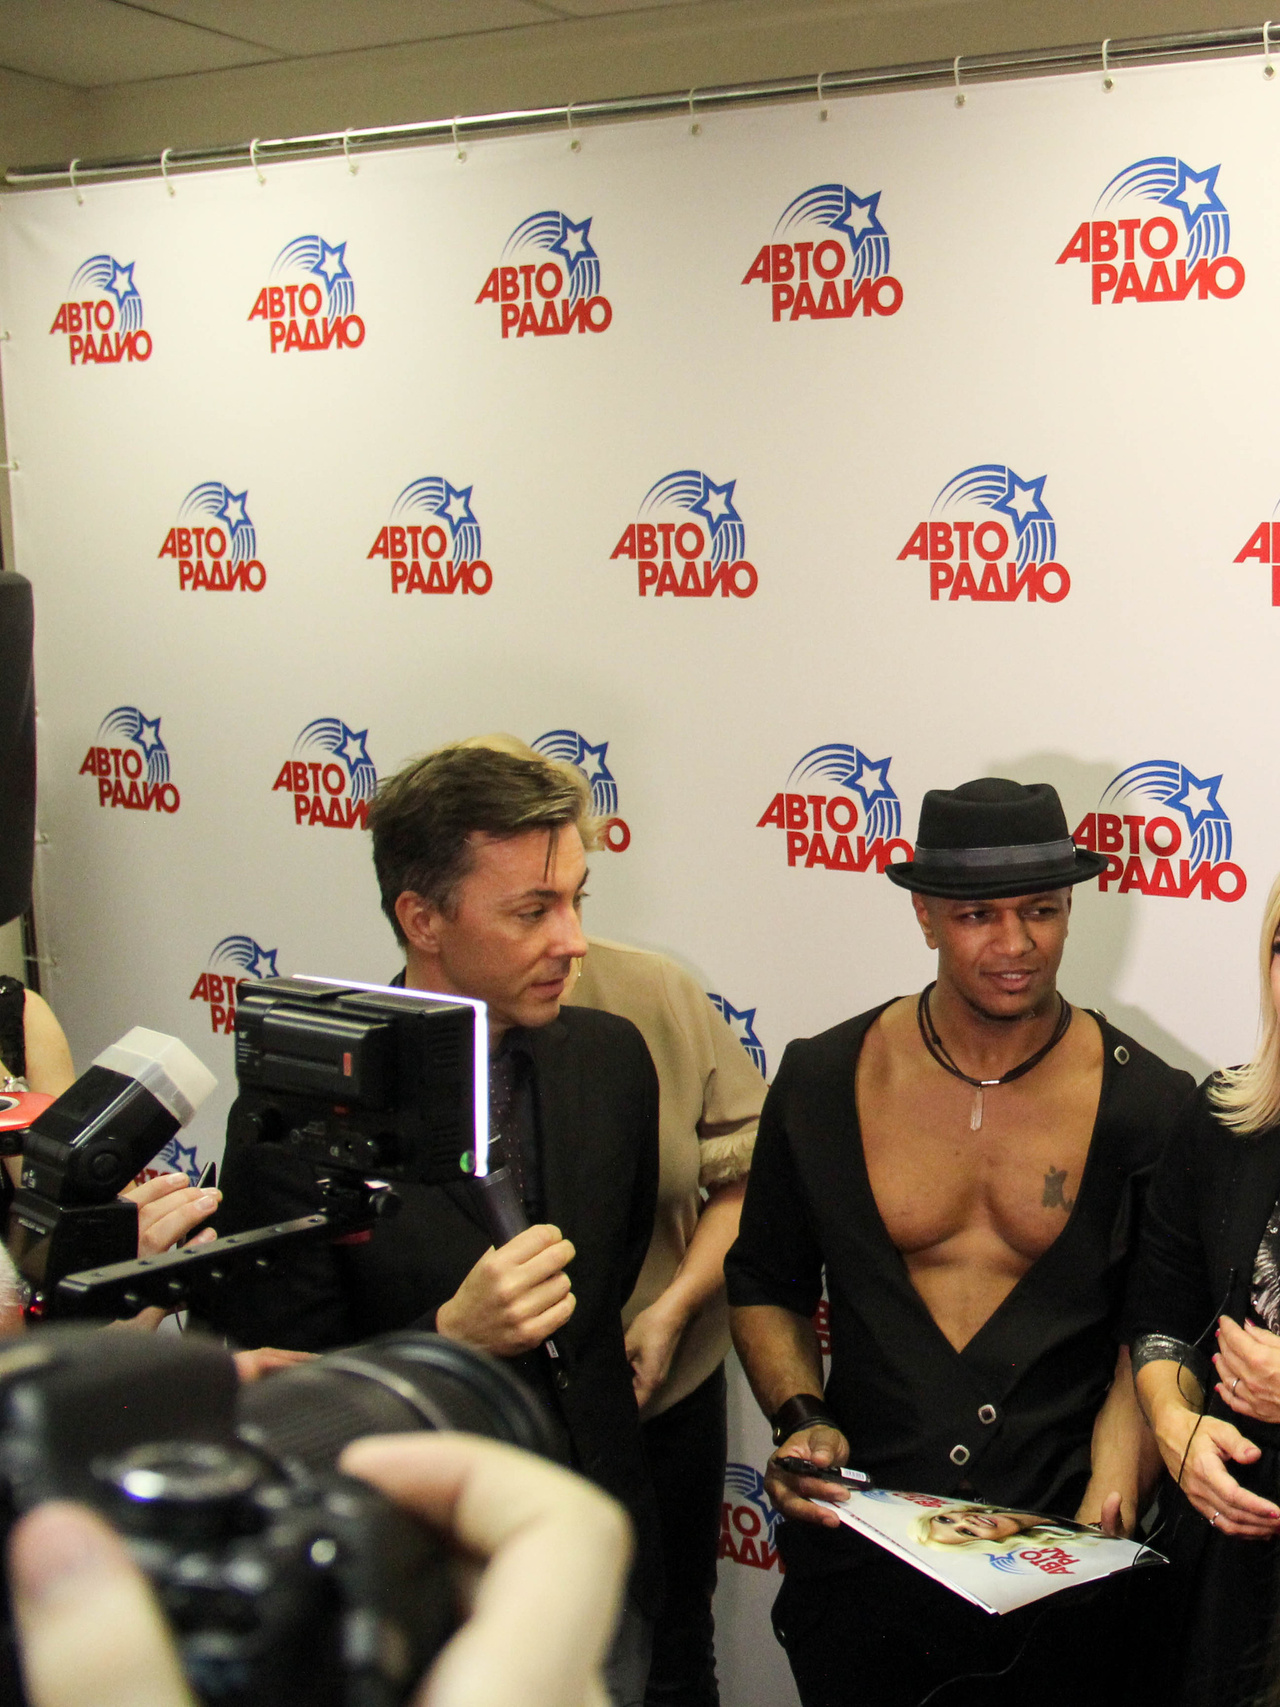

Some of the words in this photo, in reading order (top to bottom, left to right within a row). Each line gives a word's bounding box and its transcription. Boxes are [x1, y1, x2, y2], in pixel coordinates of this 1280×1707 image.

[1056, 216, 1179, 265] АВТО
[742, 239, 845, 286] АВТО
[1091, 255, 1246, 306] РАДИО
[248, 283, 323, 321] АВТО
[475, 262, 563, 305] АВТО
[772, 275, 904, 323] РАДИО
[50, 300, 115, 335] АВТО
[270, 314, 366, 354] РАДИО
[501, 295, 613, 339] РАДИО
[69, 330, 153, 366] РАДИО
[158, 527, 227, 560] АВТО
[366, 525, 447, 560] АВТО
[610, 522, 706, 561] АВТО
[896, 521, 1010, 562] АВТО
[178, 559, 267, 592] РАДИО
[390, 559, 494, 596] РАДИО
[638, 560, 759, 599] РАДИО
[929, 561, 1072, 604] РАДИО
[79, 746, 142, 779] АВТО
[271, 761, 346, 796] АВТО
[99, 778, 181, 814] РАДИО
[294, 793, 372, 831] РАДИ
[756, 792, 859, 834] АВТО
[1071, 812, 1182, 857] АВТО
[1098, 853, 1248, 903] РАДИО
[190, 972, 250, 1005] АВТ
[717, 1531, 786, 1574] АДИ
